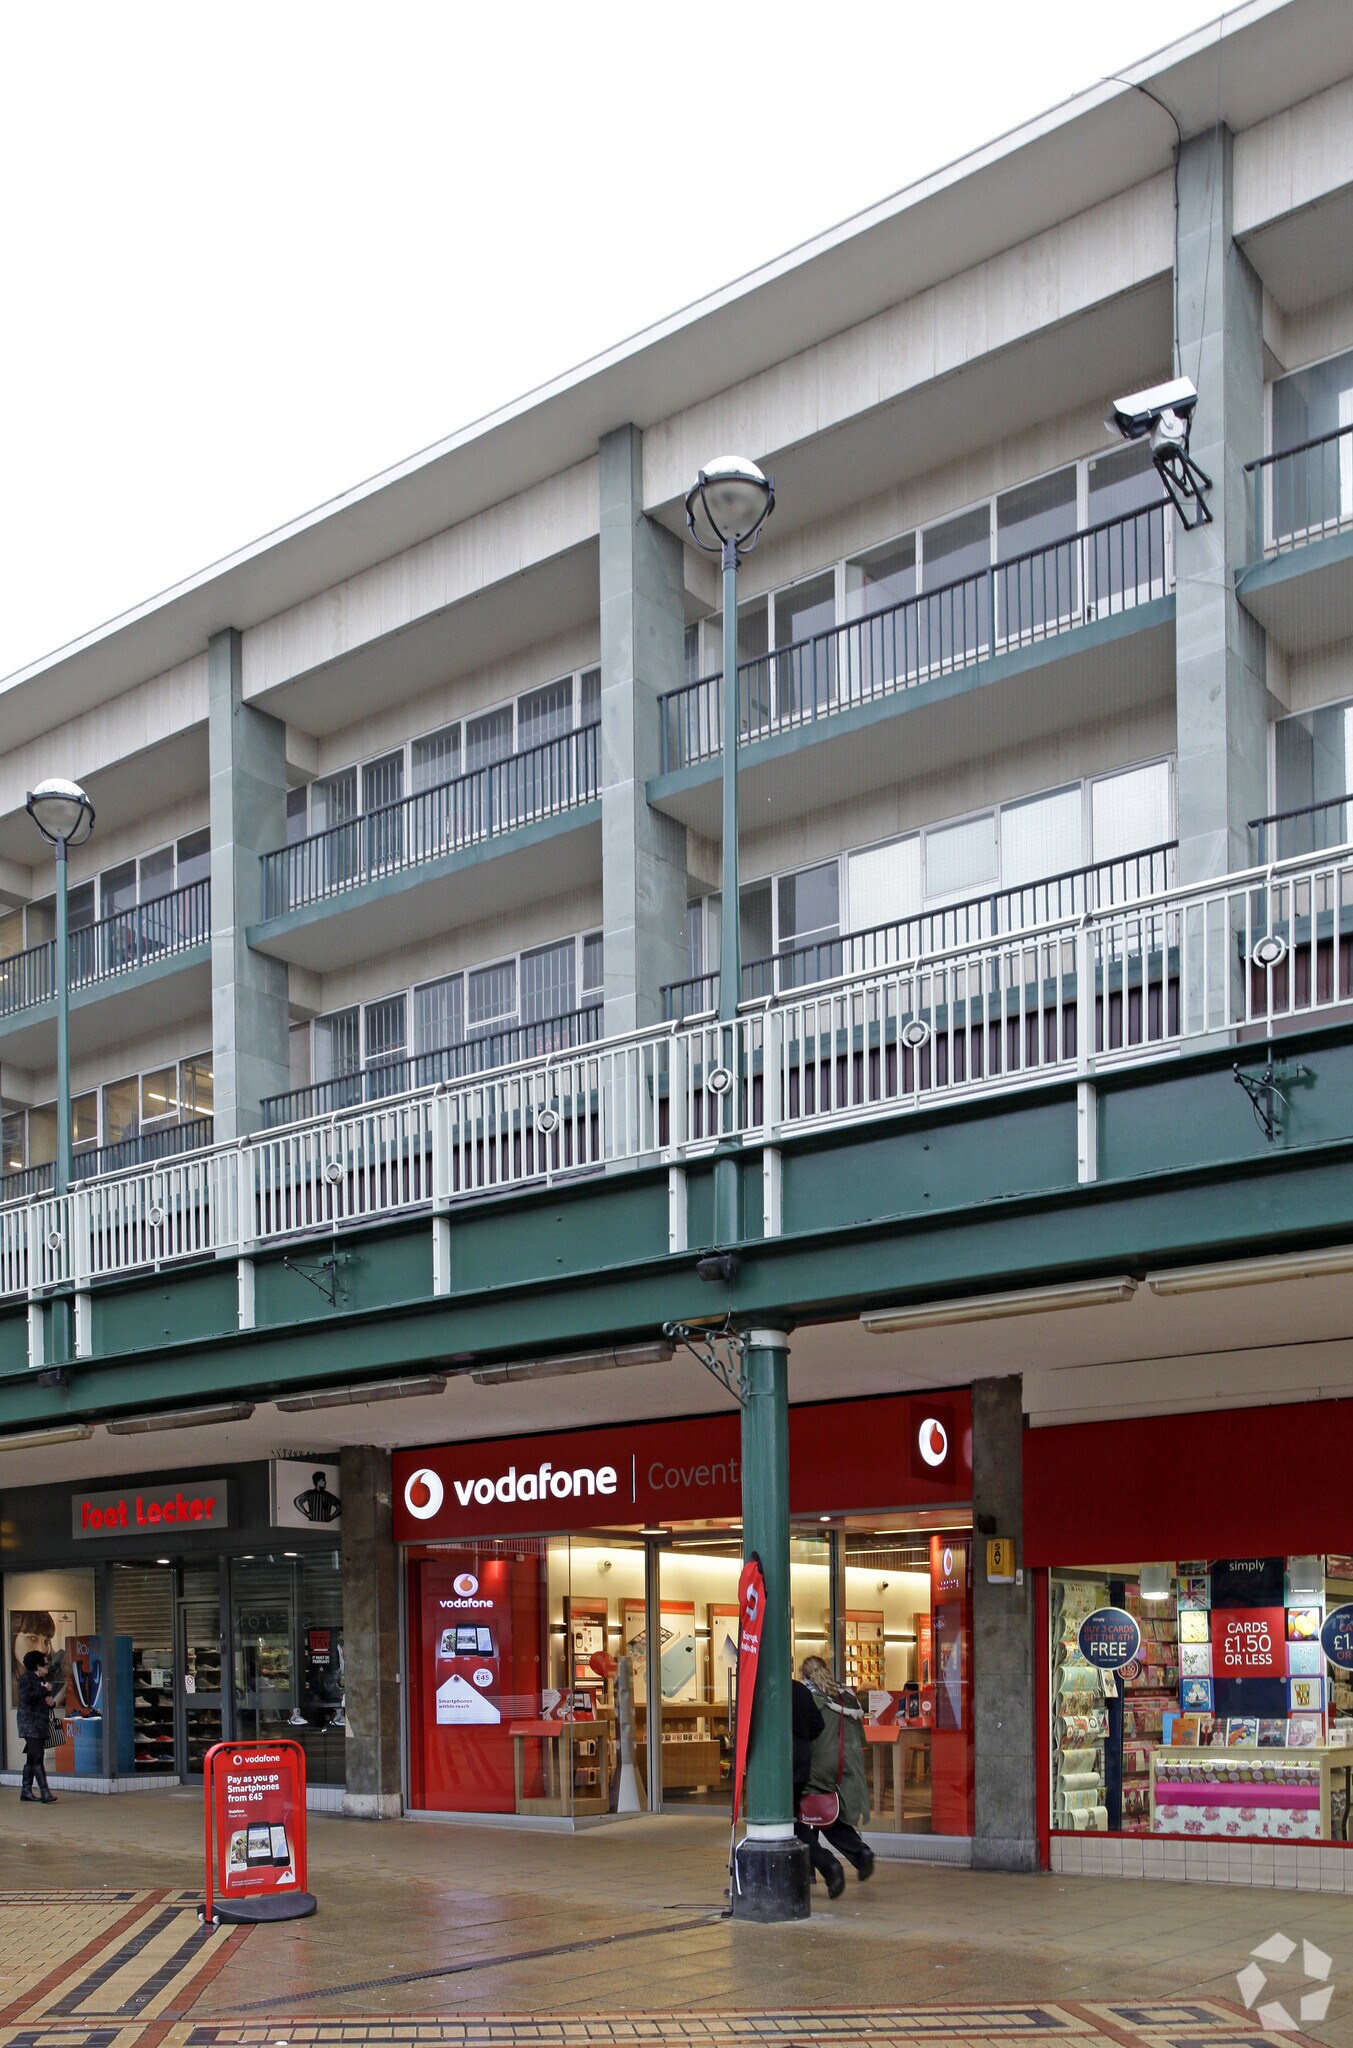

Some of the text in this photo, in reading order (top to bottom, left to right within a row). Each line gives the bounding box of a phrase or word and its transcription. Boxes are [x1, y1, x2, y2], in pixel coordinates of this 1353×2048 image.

[648, 1458, 742, 1490] Covent
[454, 1463, 617, 1506] vodafone
[81, 1492, 216, 1530] Foot Locker
[1229, 1560, 1265, 1572] simply
[439, 1598, 494, 1608] vodafone
[1101, 1625, 1106, 1633] 3
[1107, 1625, 1134, 1633] CARDS
[1227, 1621, 1268, 1634] CARDS
[1090, 1641, 1127, 1657] FREE
[1224, 1634, 1272, 1653] £1.50
[1224, 1653, 1273, 1666] OR LESS
[1337, 1652, 1351, 1660] OR
[244, 1754, 281, 1763] vodafone
[227, 1774, 279, 1785] Pay as you go
[227, 1783, 280, 1793] Smartphones
[227, 1794, 247, 1803] from
